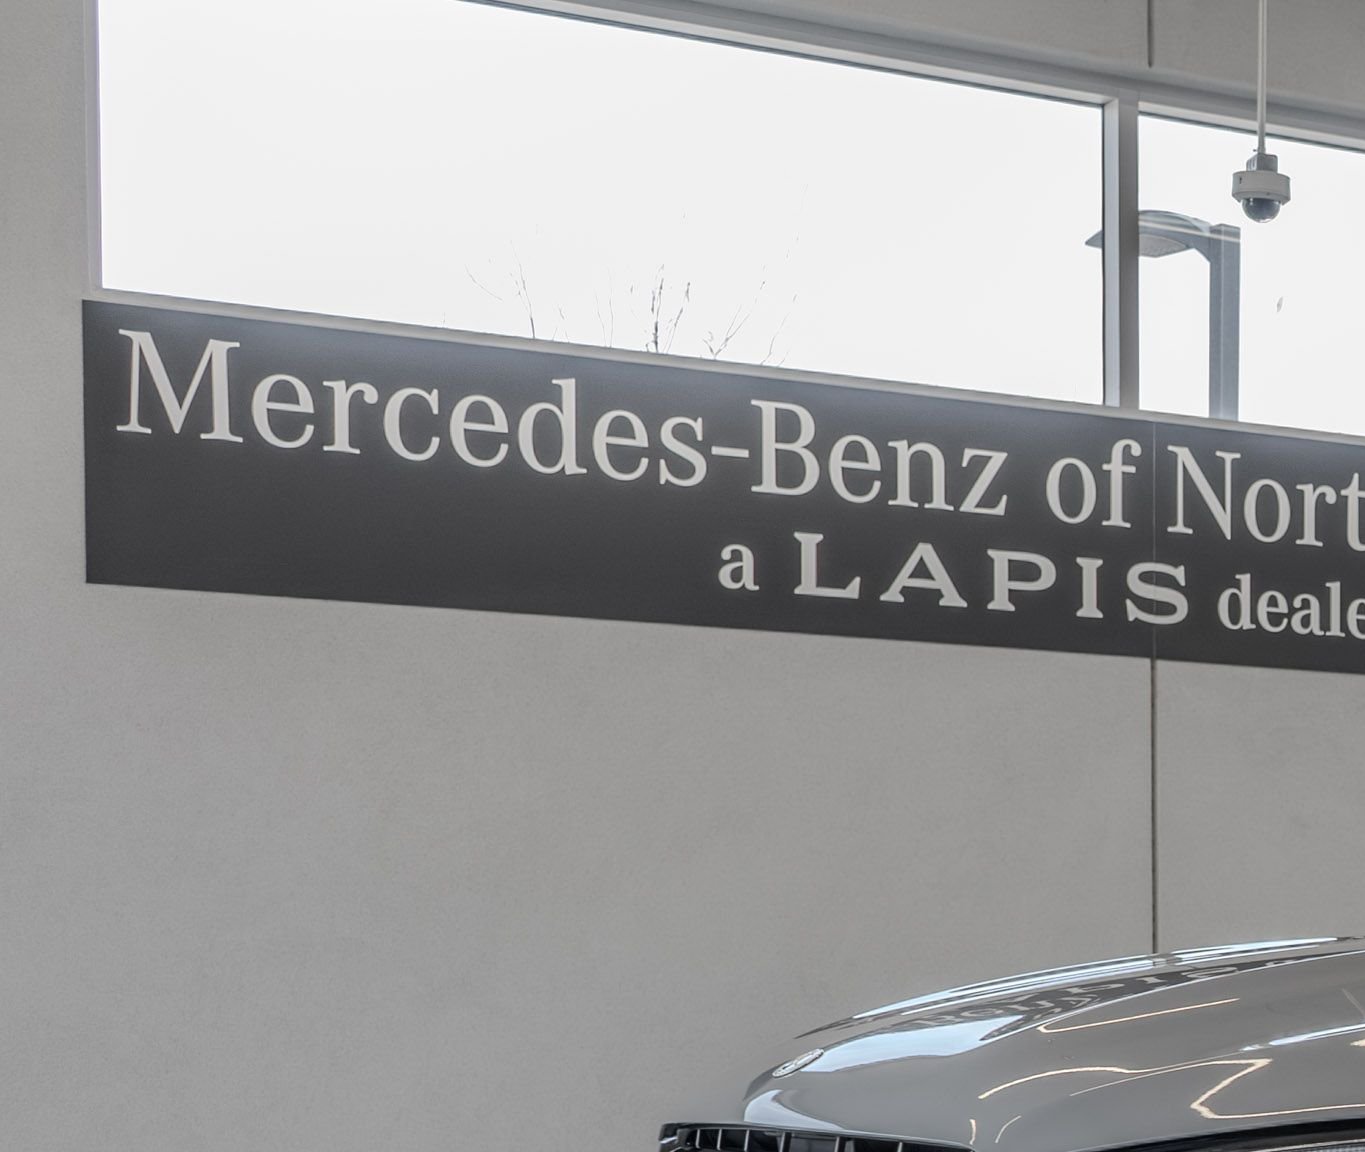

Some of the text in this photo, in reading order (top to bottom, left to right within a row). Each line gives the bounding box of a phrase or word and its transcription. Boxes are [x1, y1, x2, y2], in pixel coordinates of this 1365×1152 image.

[116, 328, 1009, 516] Mercedes-Benz
[1045, 438, 1142, 529] of
[718, 543, 760, 591] a
[793, 531, 1188, 625] LAPIS
